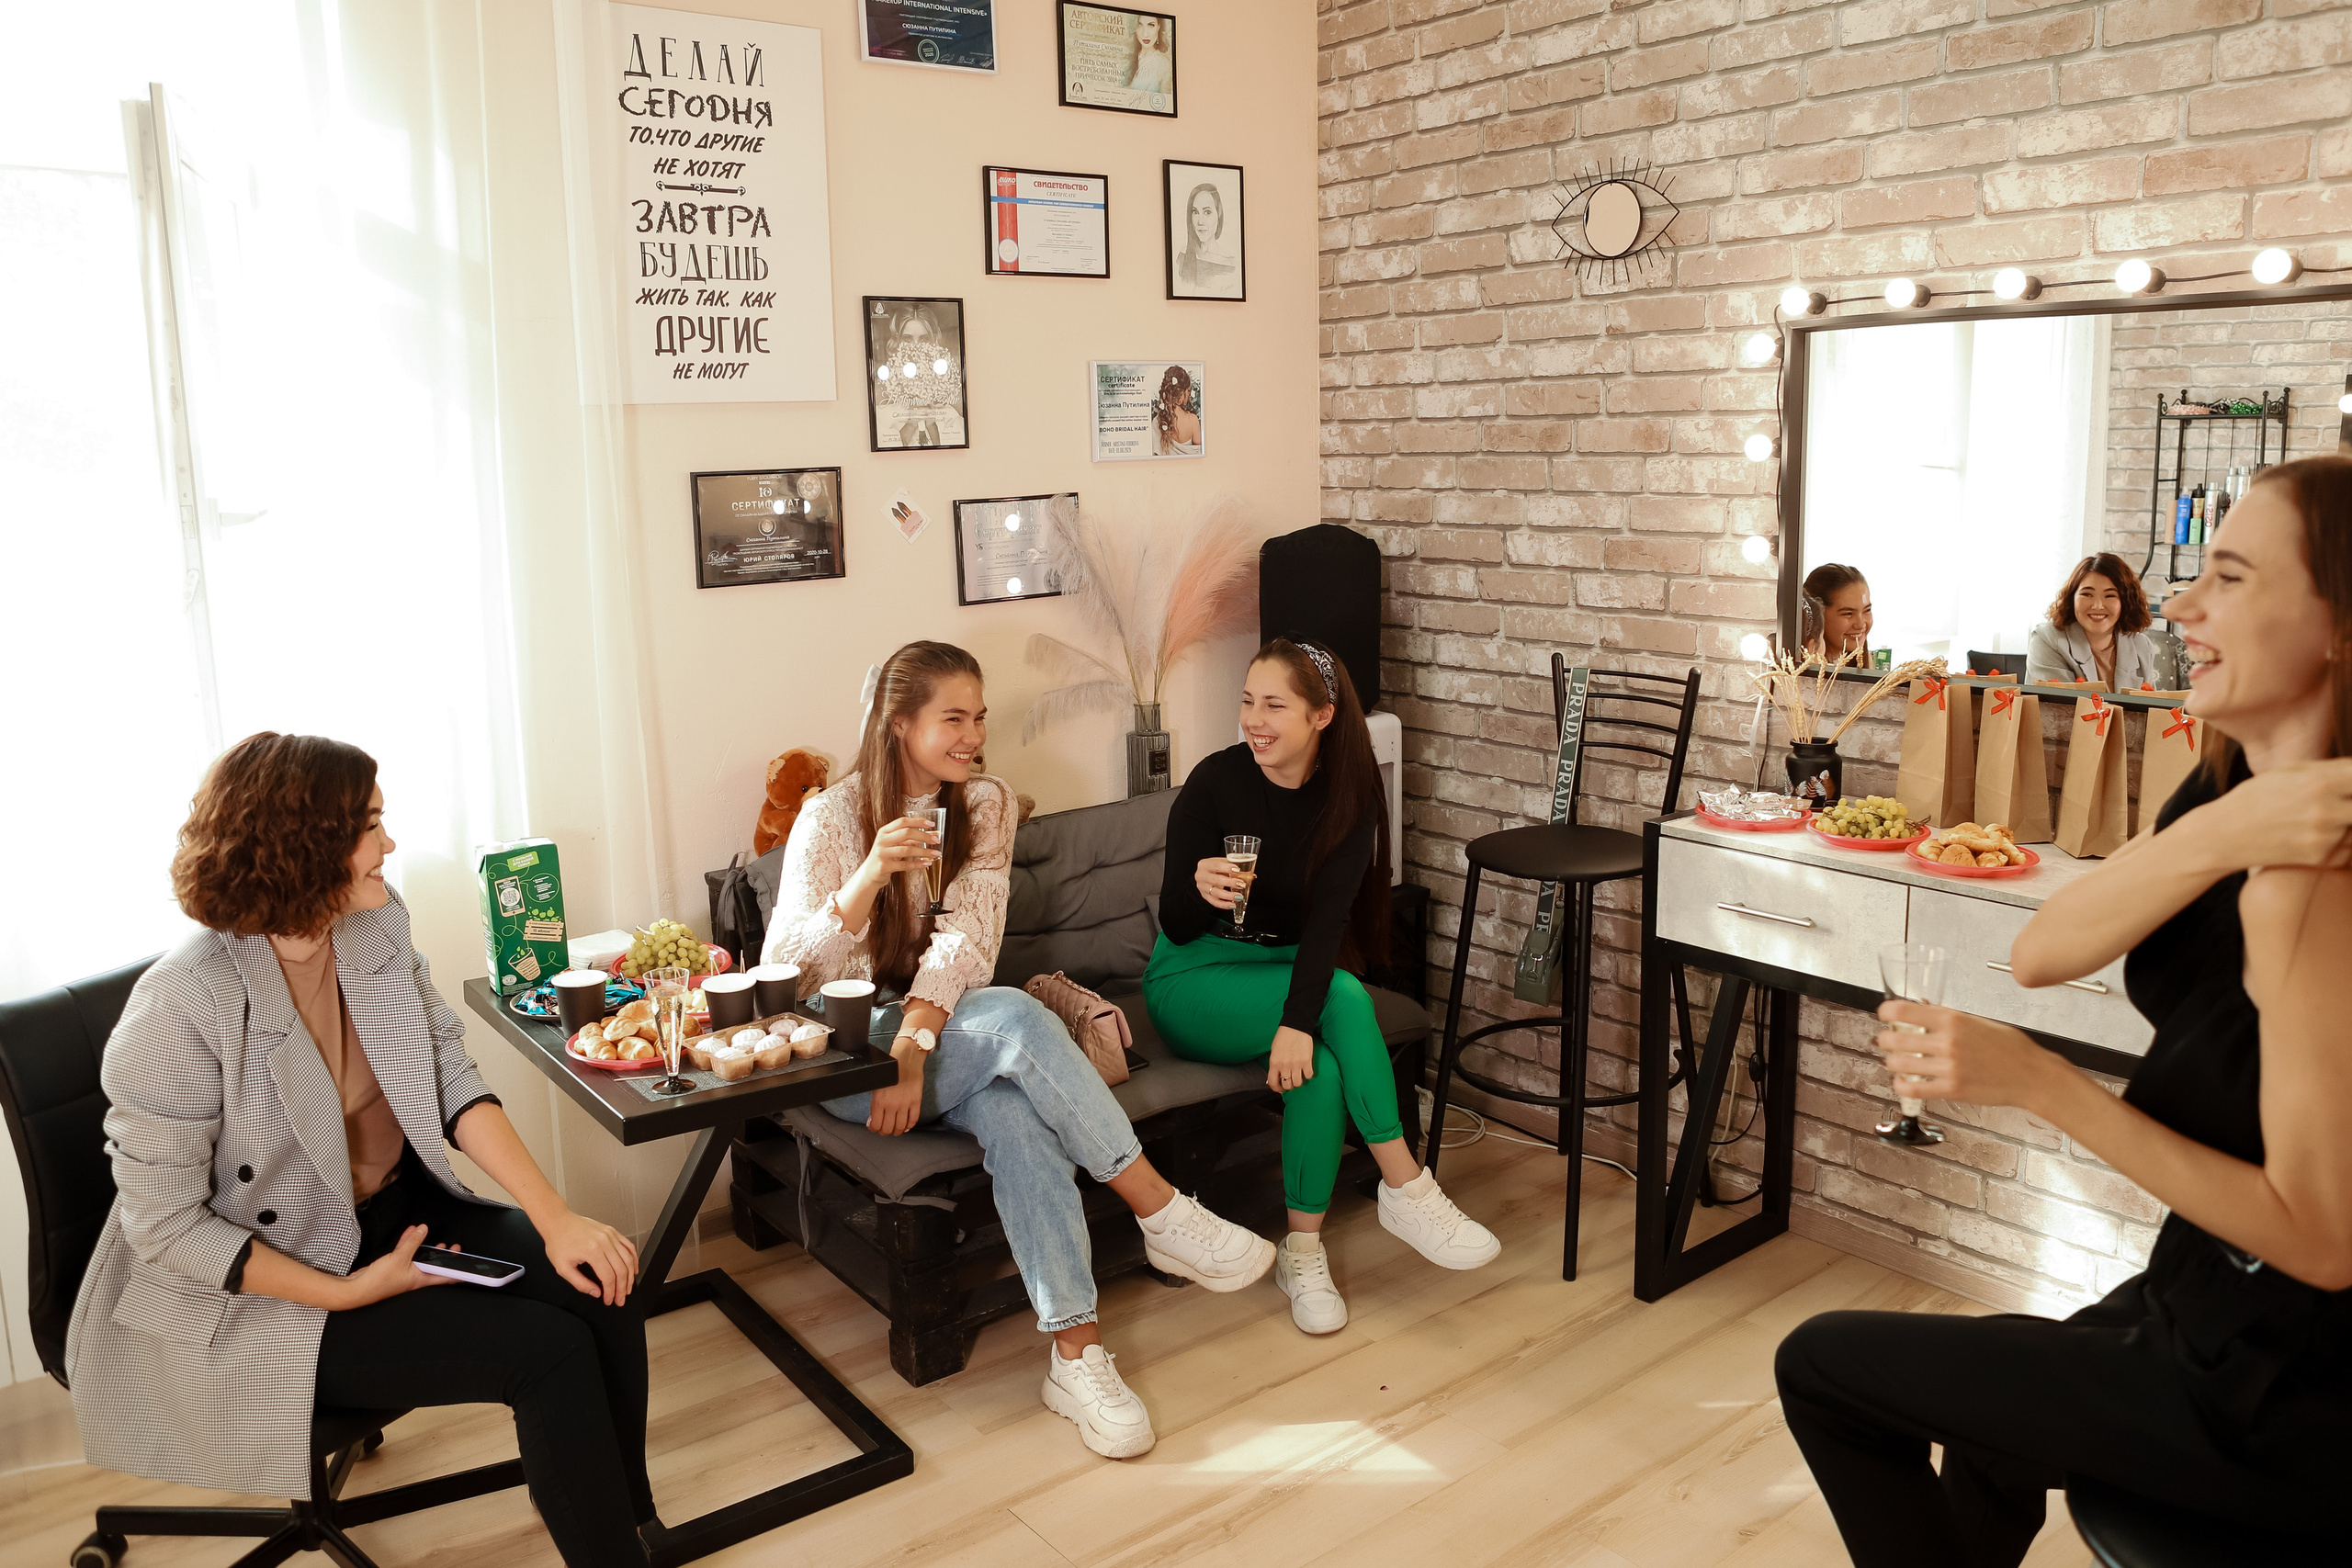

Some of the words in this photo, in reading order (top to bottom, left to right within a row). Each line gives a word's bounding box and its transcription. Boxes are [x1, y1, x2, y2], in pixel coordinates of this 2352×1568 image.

[903, 0, 953, 13] INTERNATIONAL
[1069, 19, 1125, 36] СЕРТИФИКАТ
[1071, 10, 1124, 26] АВТОРСКИЙ
[624, 33, 764, 87] ДЕЛАЙ
[618, 85, 773, 129] СЕГОДНЯ
[695, 132, 765, 152] ДРУГИЕ
[653, 157, 680, 175] НЕ
[683, 159, 746, 179] ХОТЯТ
[1033, 180, 1089, 192] СВИДЕТЕЛЬСТВО
[631, 199, 772, 239] ЗАВТРА
[639, 242, 769, 286] БУДЕШЬ
[635, 288, 689, 306] ЖИТЬ
[695, 289, 729, 308] ТАК,
[740, 290, 777, 309] КАК
[655, 315, 771, 357] ДРУГИЕ
[673, 363, 695, 379] НЕ
[697, 362, 750, 380] МОГУТ
[731, 498, 800, 511] СЕРТИФКАТ
[743, 555, 762, 563] ЮРИЙ
[763, 553, 795, 561] СТОЛЯРОВ
[1563, 682, 1586, 745] PRADA
[1552, 758, 1574, 821] PRADA
